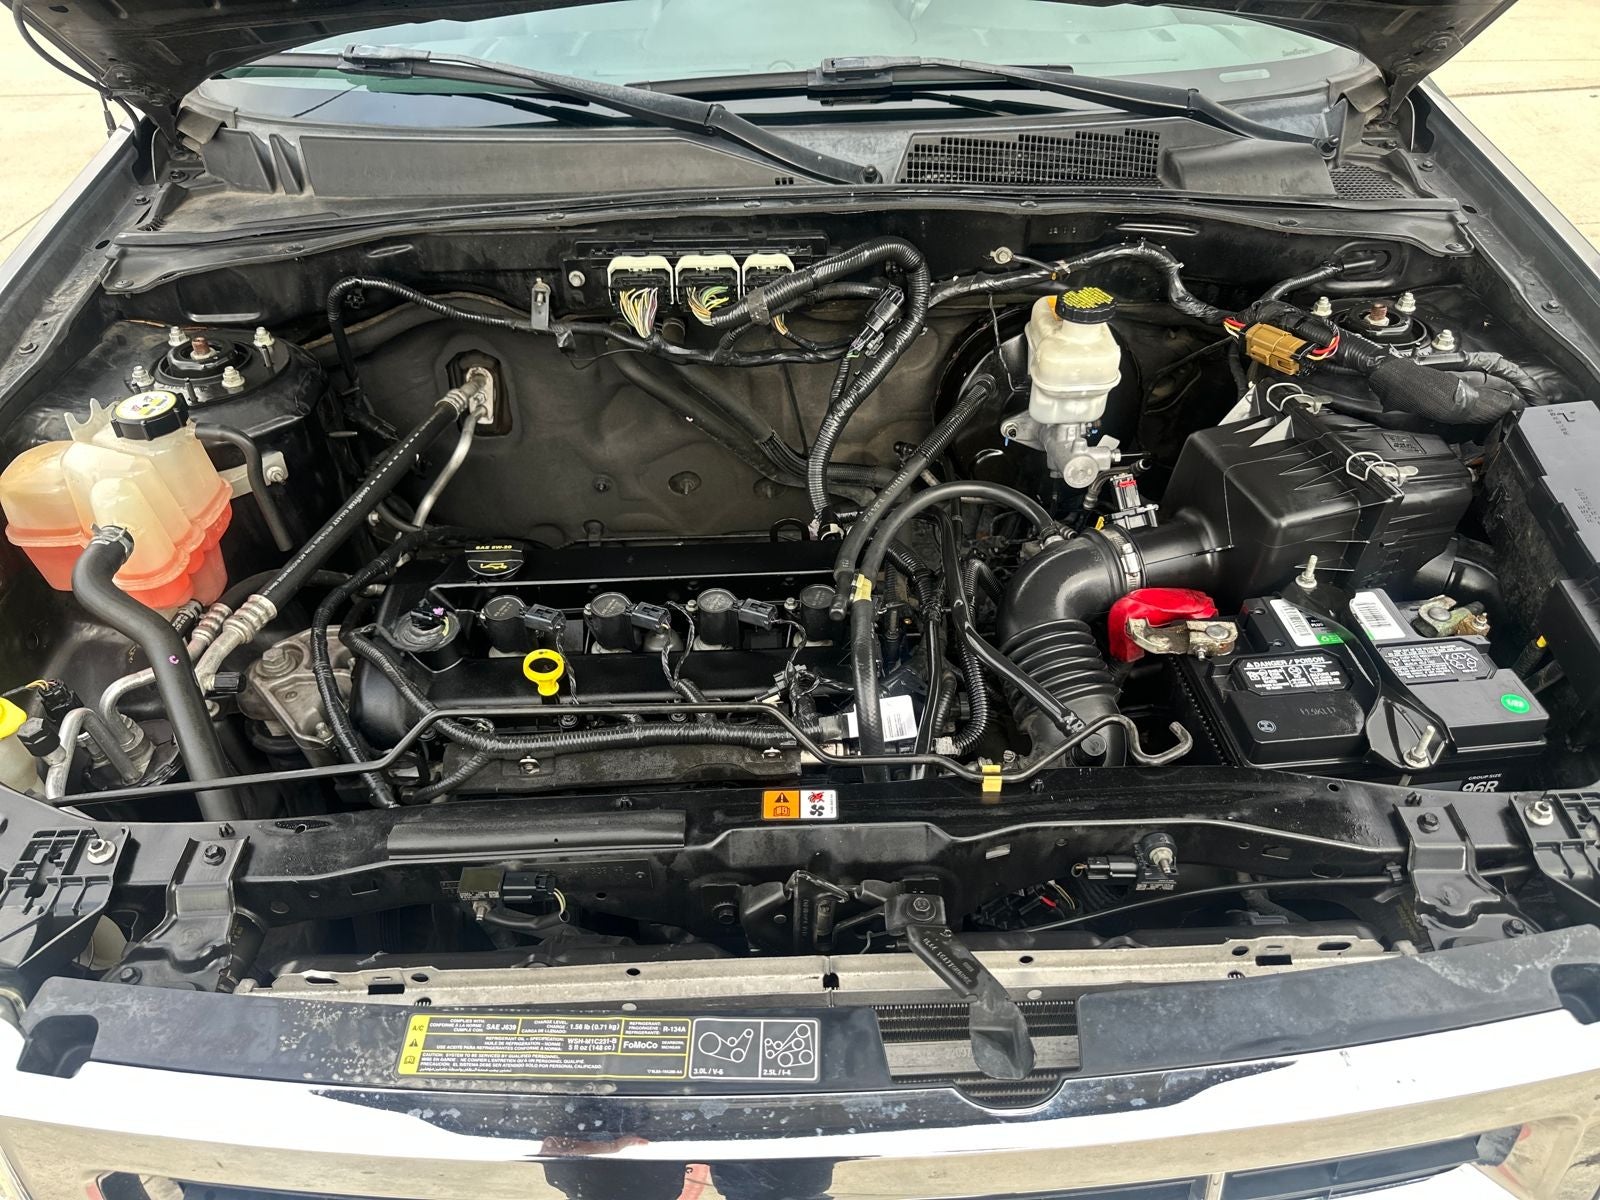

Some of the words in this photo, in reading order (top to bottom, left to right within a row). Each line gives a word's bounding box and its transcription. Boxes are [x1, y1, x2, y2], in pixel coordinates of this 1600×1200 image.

[1253, 660, 1288, 668] DANGER
[1294, 656, 1326, 664] POISON
[622, 1040, 658, 1049] FoMoCo
